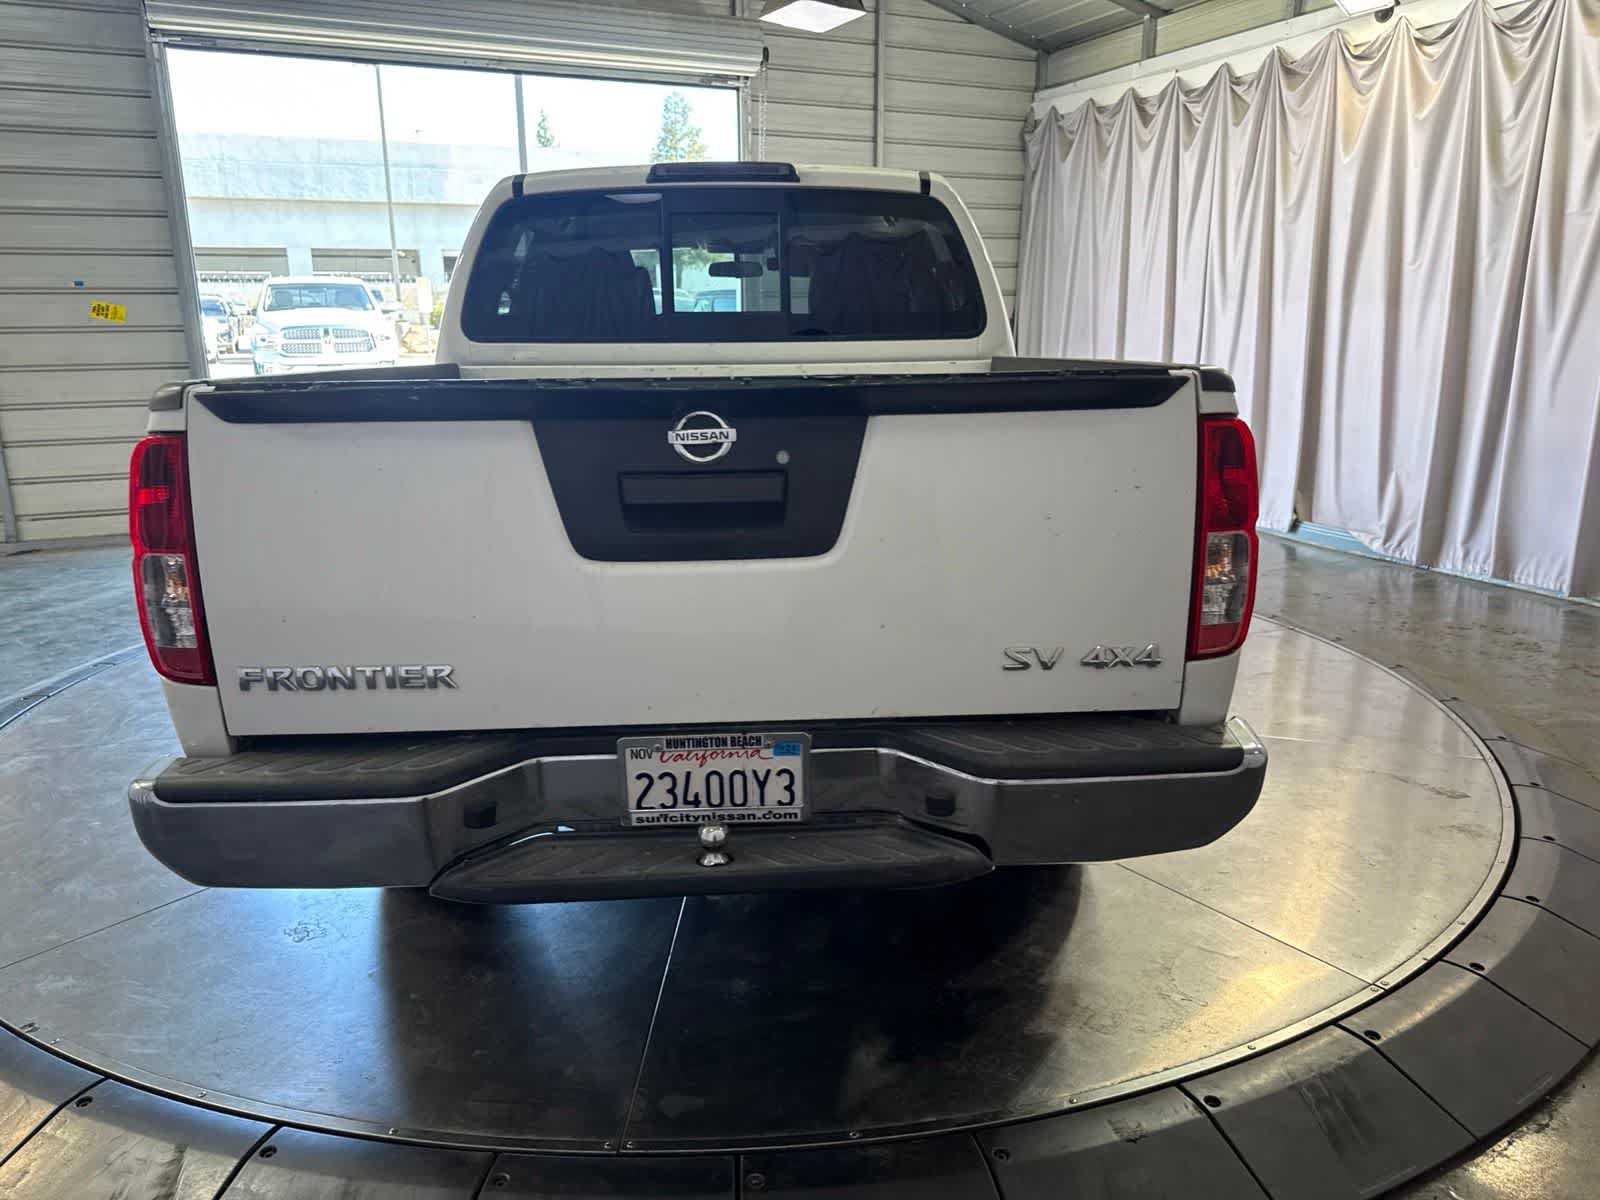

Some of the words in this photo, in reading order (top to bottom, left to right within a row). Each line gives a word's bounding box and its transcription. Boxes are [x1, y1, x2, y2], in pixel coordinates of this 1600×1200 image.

[675, 431, 729, 441] NISSAN
[1002, 646, 1065, 671] SV
[238, 664, 460, 692] FRONTIER
[665, 736, 725, 749] HUNTINGTON
[730, 735, 762, 748] BEACH
[630, 749, 653, 760] NOV
[659, 748, 774, 768] California
[635, 768, 796, 810] 23400Y3
[635, 810, 798, 824] surfcitynissan.com
